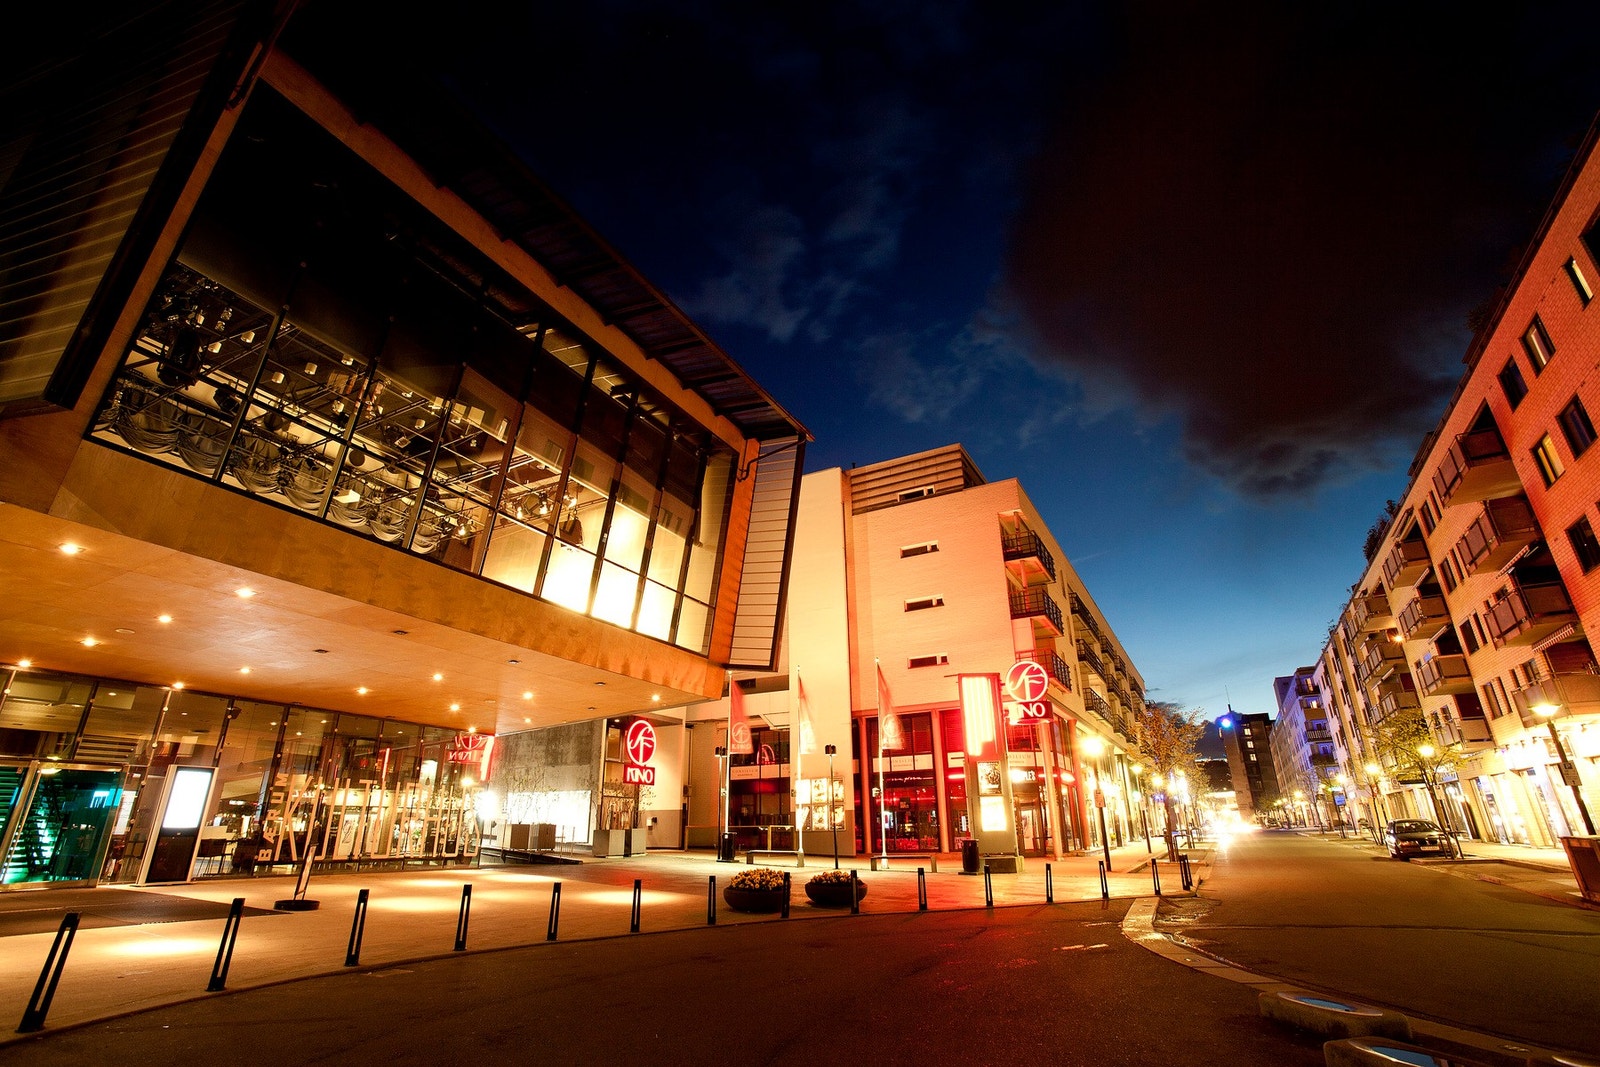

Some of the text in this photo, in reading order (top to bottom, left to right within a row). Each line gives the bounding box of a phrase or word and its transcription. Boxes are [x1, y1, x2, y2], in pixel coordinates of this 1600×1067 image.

[258, 773, 289, 862] BÆRUM
[274, 774, 485, 862] KULTURHUS
[627, 767, 654, 784] KINO
